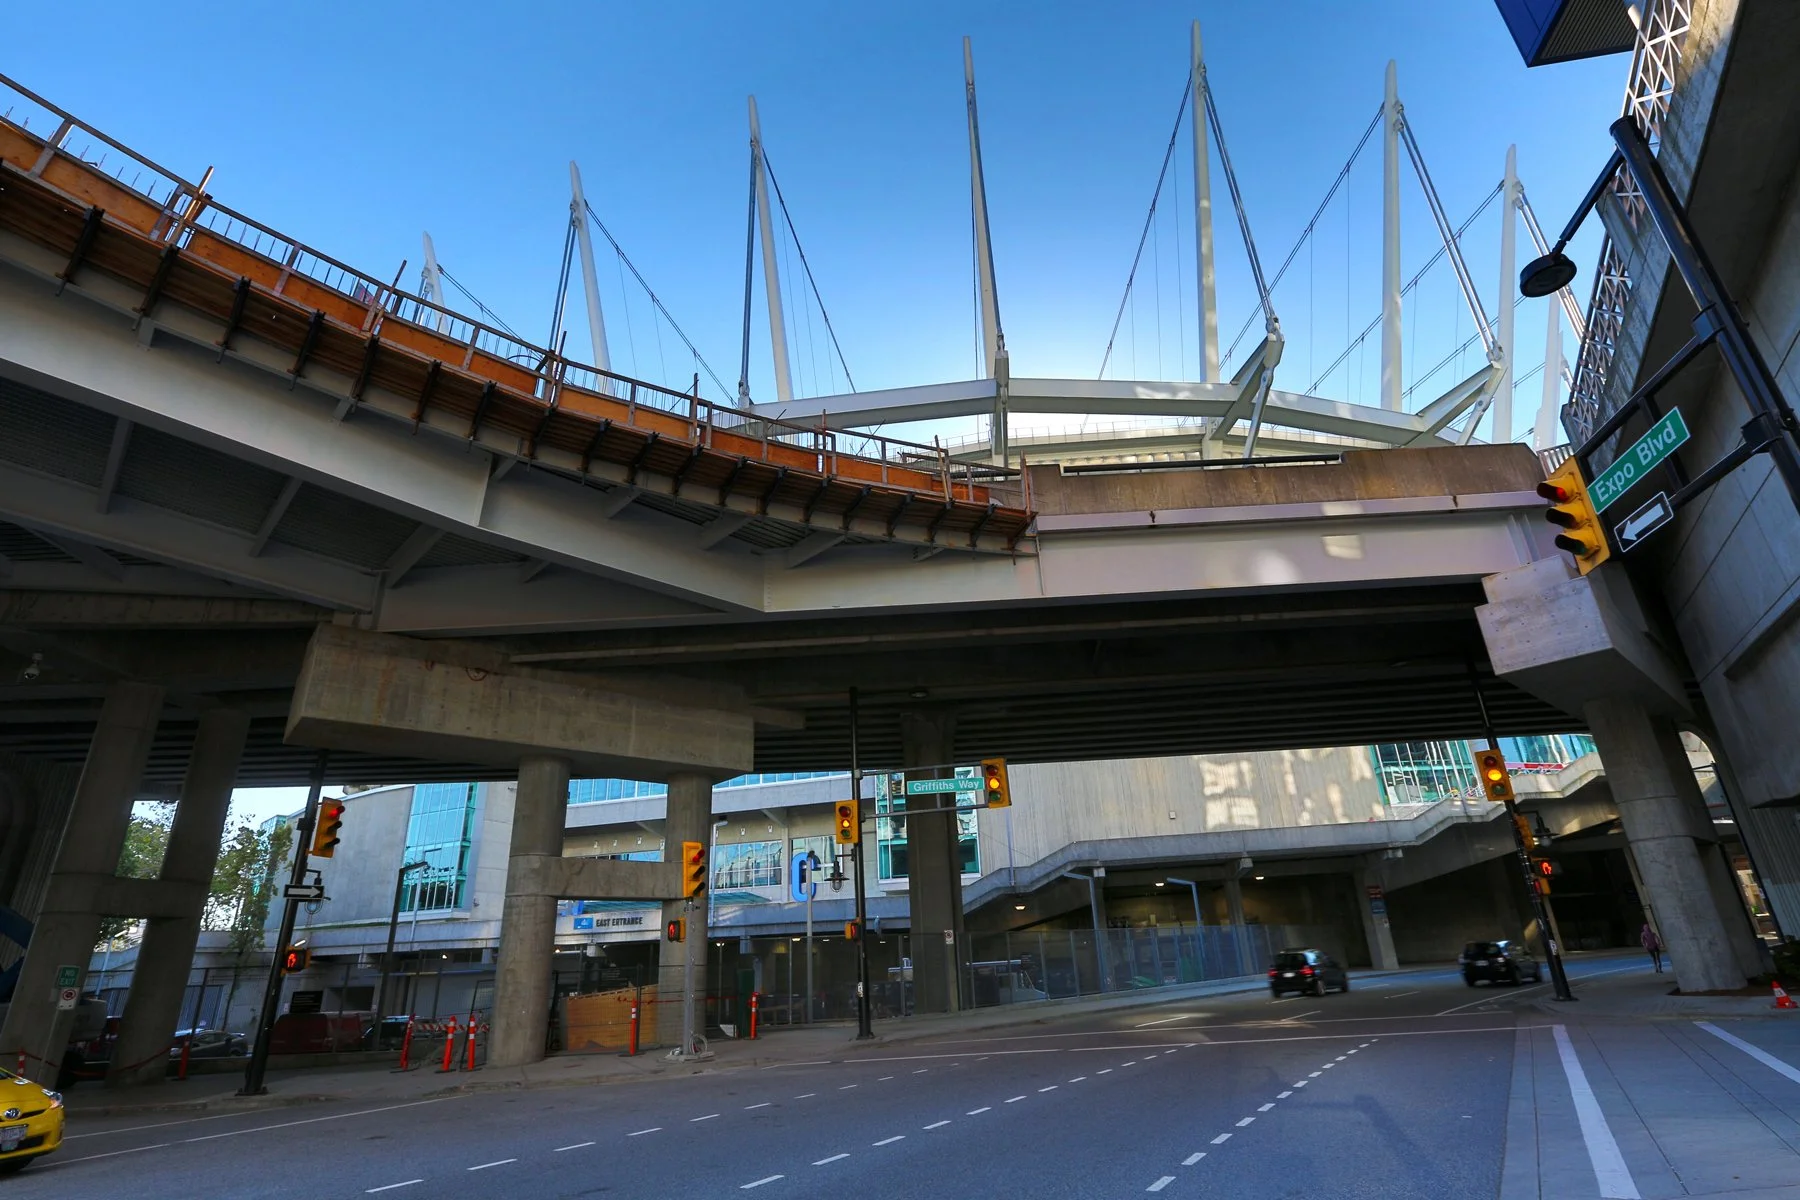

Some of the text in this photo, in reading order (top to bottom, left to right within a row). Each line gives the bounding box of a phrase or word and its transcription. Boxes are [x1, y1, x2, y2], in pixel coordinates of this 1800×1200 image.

[1594, 420, 1677, 503] Expo Blvd
[913, 779, 980, 792] Griffiths Way
[791, 851, 822, 903] C
[595, 916, 644, 928] EAST ENTRANCE
[64, 969, 75, 977] NO
[59, 977, 76, 986] EXIT
